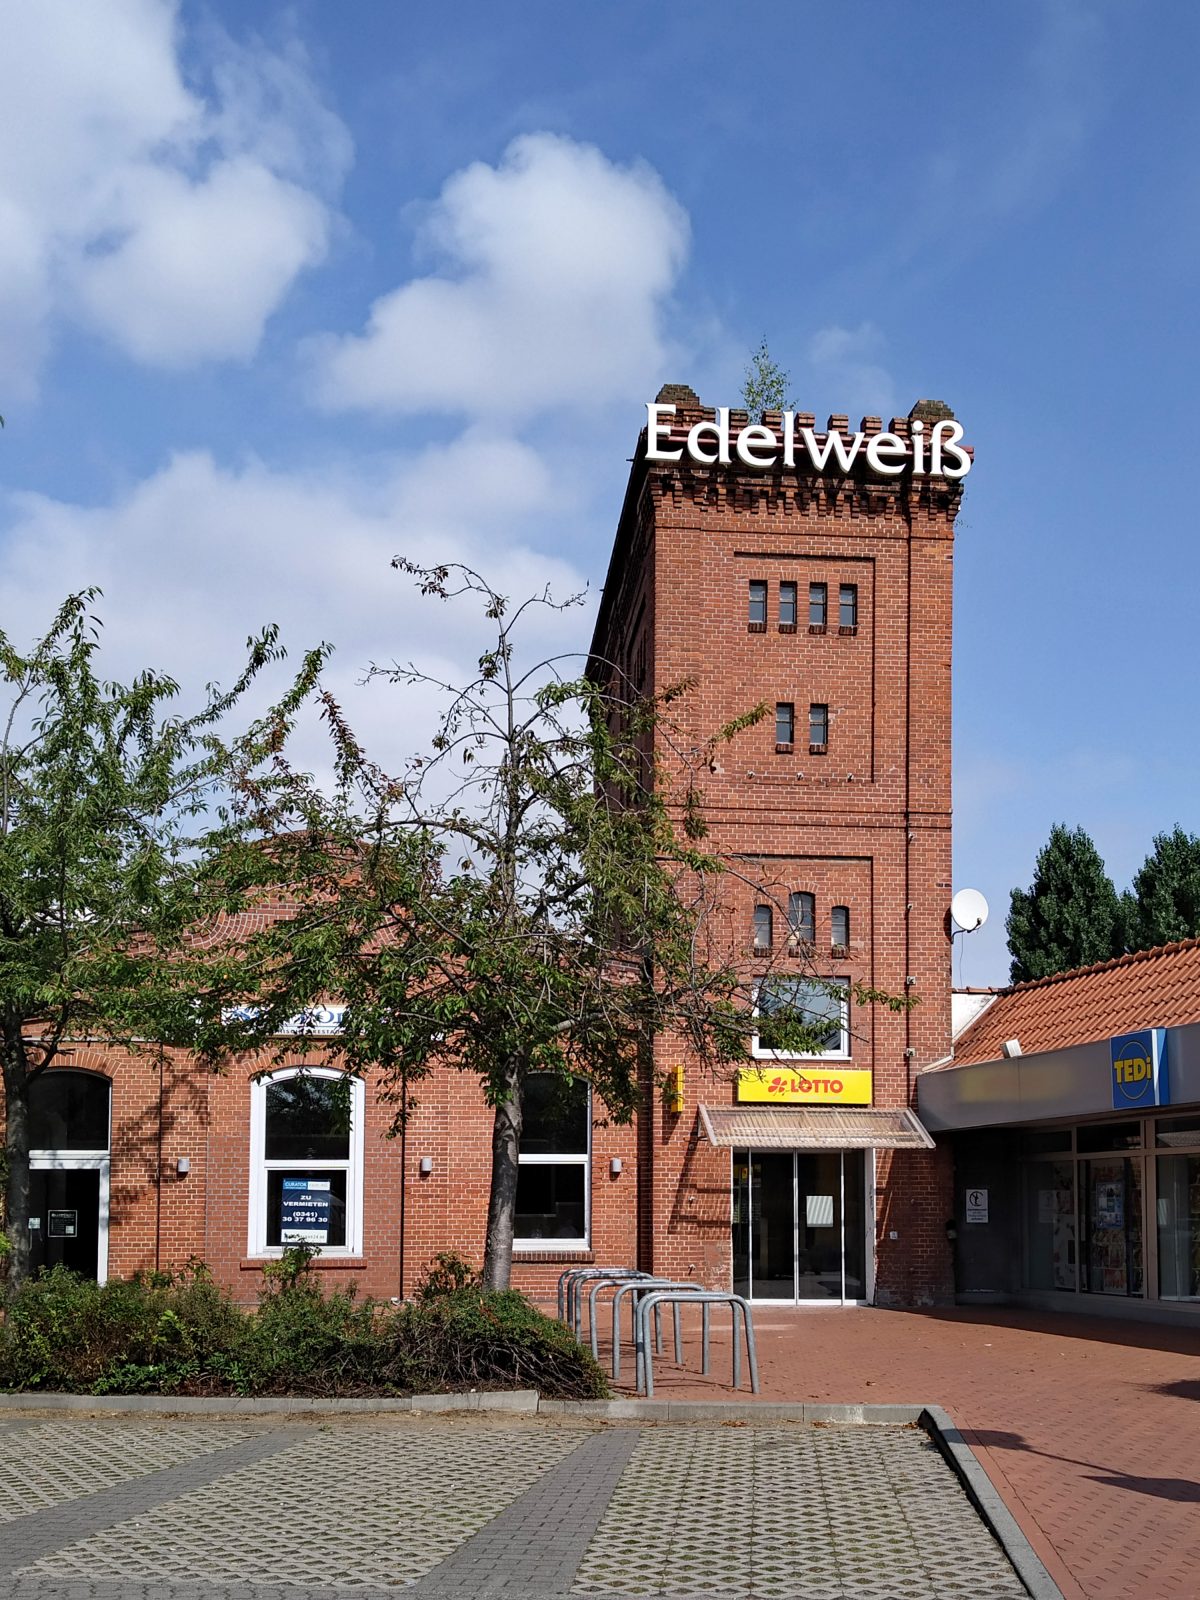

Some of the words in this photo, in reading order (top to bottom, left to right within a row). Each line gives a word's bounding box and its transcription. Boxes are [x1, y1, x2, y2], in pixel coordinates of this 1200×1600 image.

[645, 403, 971, 479] Edelweiß
[1114, 1056, 1152, 1083] TEDi
[791, 1079, 843, 1093] LOTTO
